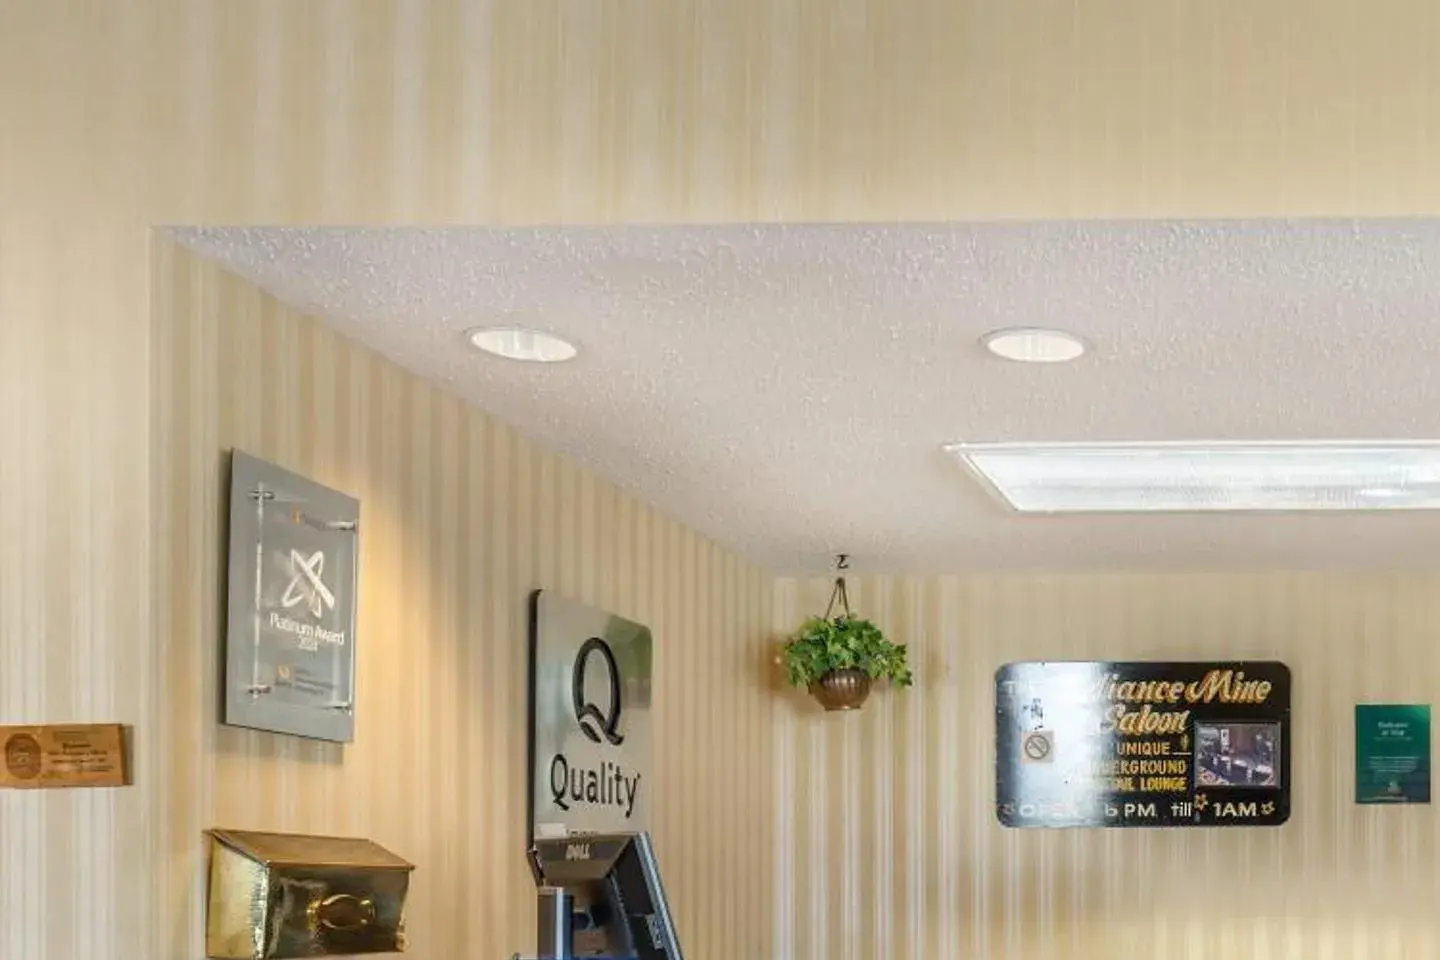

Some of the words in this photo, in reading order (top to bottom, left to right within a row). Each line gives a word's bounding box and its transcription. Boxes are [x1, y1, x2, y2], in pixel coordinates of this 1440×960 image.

[270, 612, 315, 637] Platinum
[314, 625, 345, 646] Award
[571, 636, 625, 746] Q
[1184, 669, 1272, 704] Mine
[1103, 704, 1191, 736] Saloon
[1117, 741, 1171, 756] UNIQUE
[1092, 760, 1187, 775] ERGROUND
[550, 753, 639, 818] Quality
[1140, 777, 1187, 792] LOUNGE
[1170, 802, 1192, 818] till
